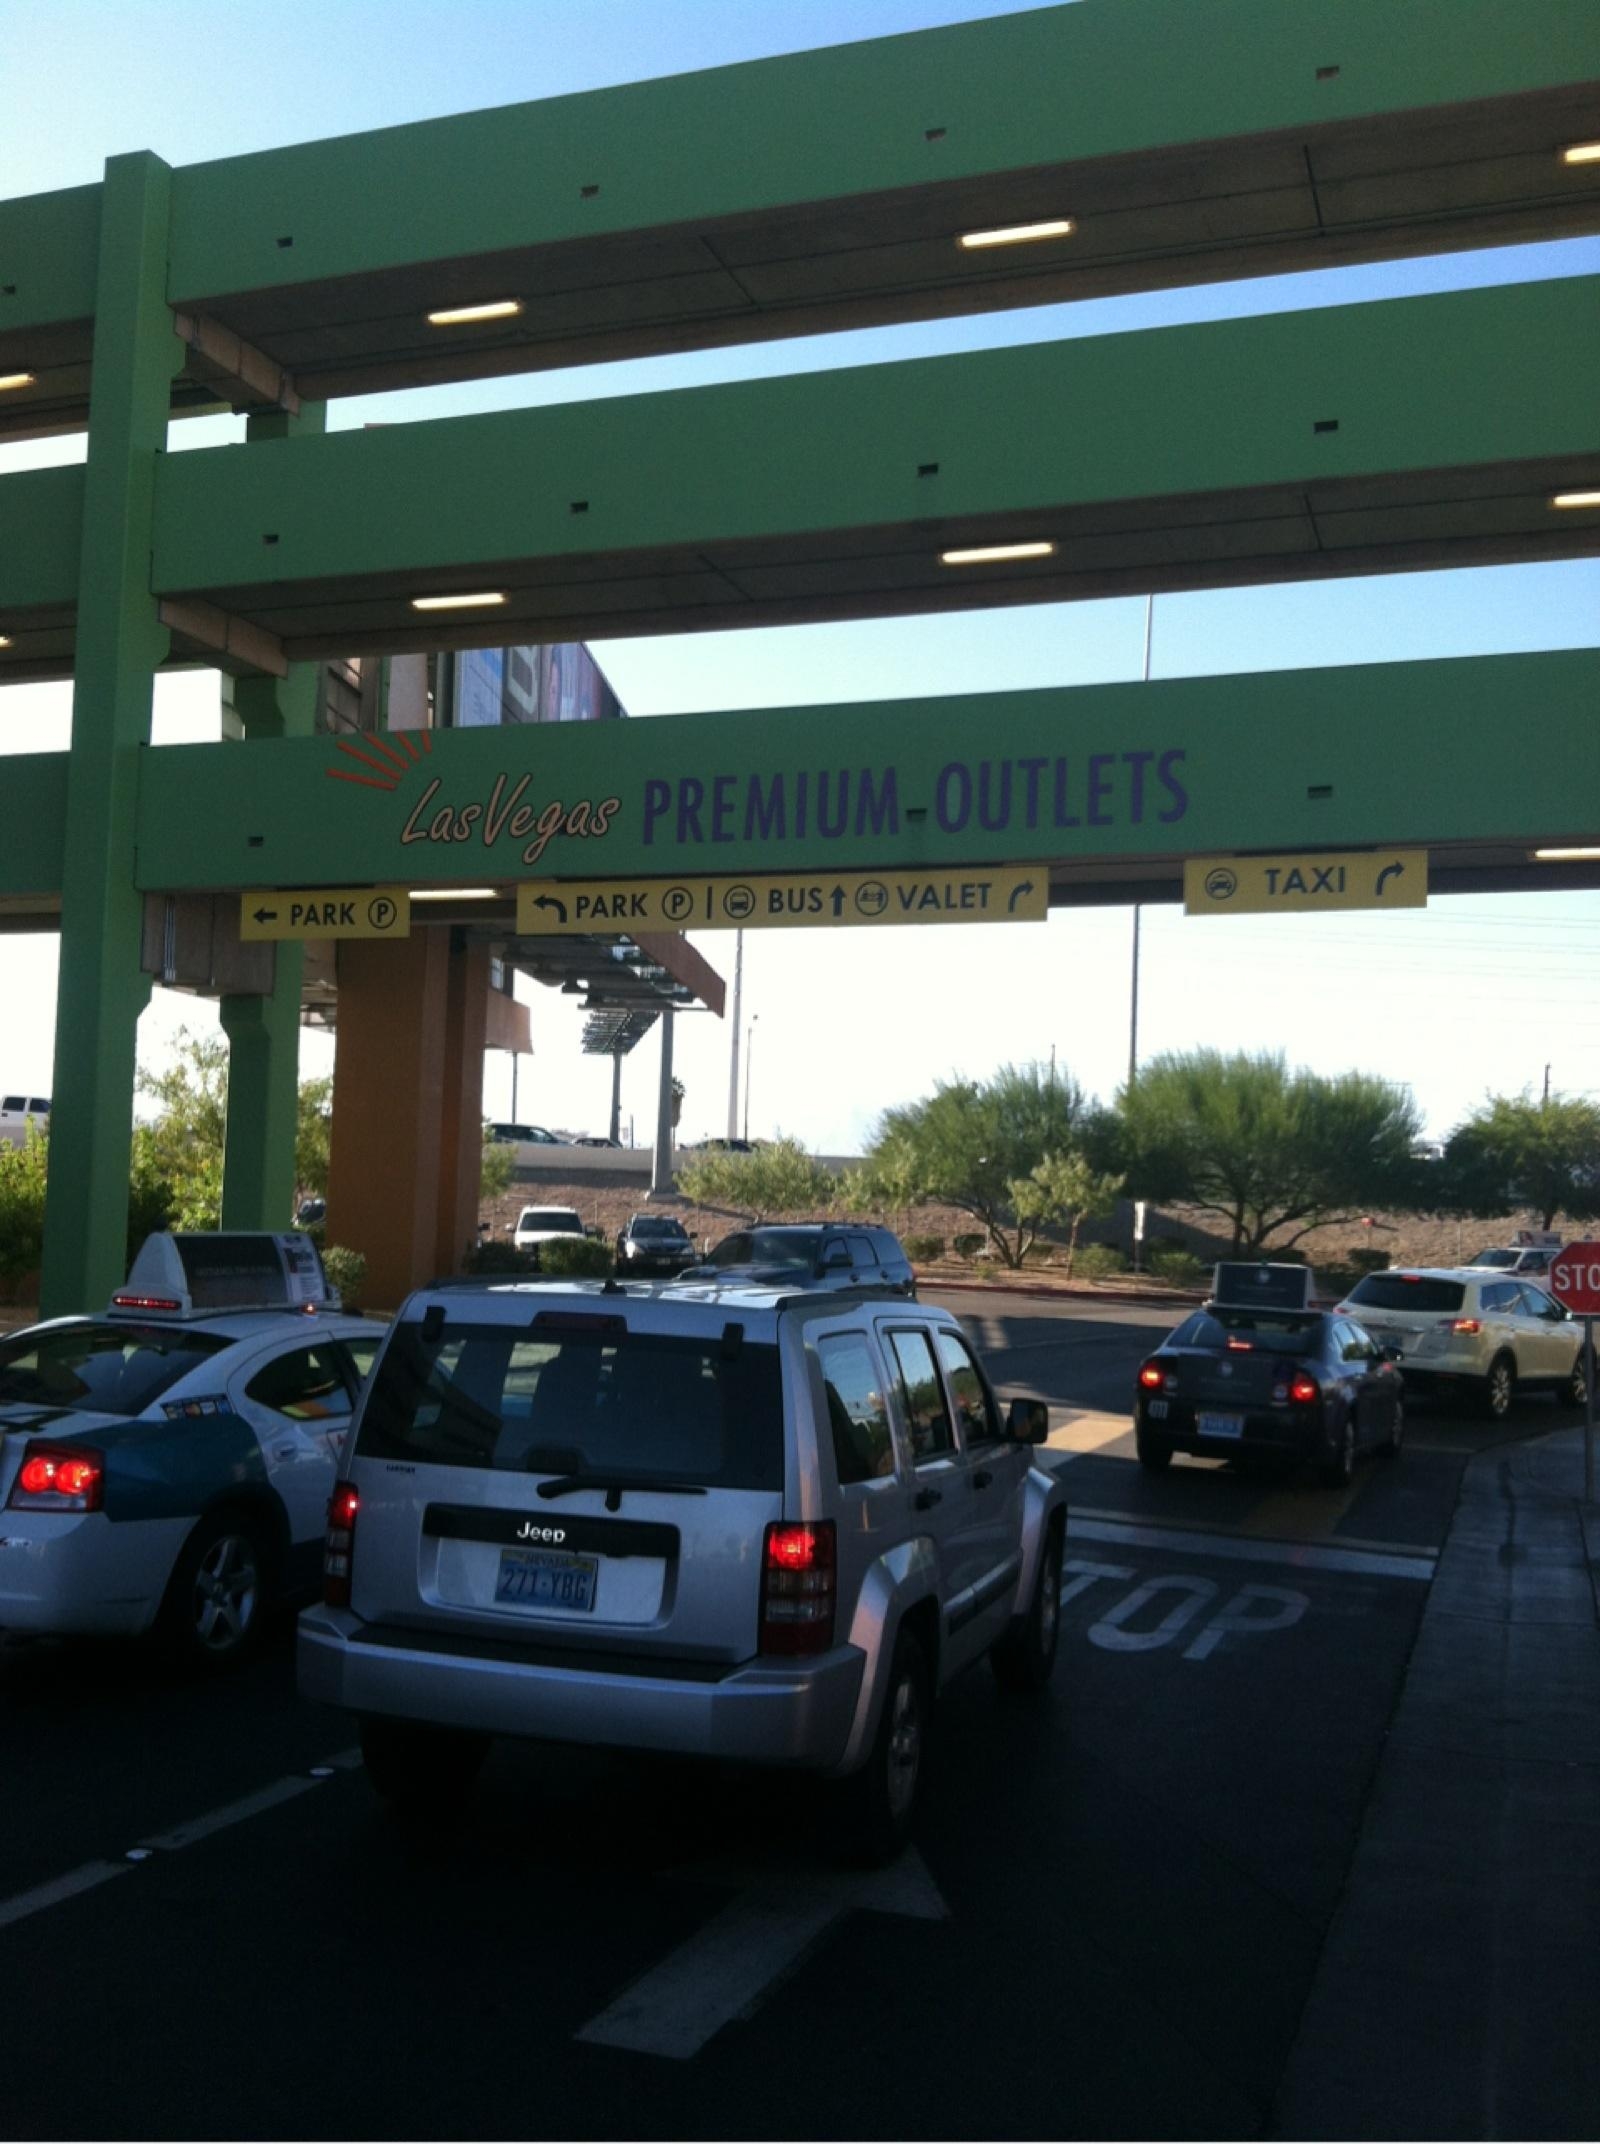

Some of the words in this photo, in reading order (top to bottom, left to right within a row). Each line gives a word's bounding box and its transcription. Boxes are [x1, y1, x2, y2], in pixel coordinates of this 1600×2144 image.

[642, 766, 901, 845] PREMIUM
[936, 749, 1190, 834] OUTLETS
[1265, 867, 1346, 895] TAXI
[290, 903, 356, 926] PARK
[575, 893, 649, 919] PARK
[767, 888, 823, 913] BUS
[896, 883, 992, 910] VALET
[1554, 1264, 1600, 1291] STO
[516, 1522, 566, 1543] Jeep
[1060, 1560, 1310, 1661] TOP
